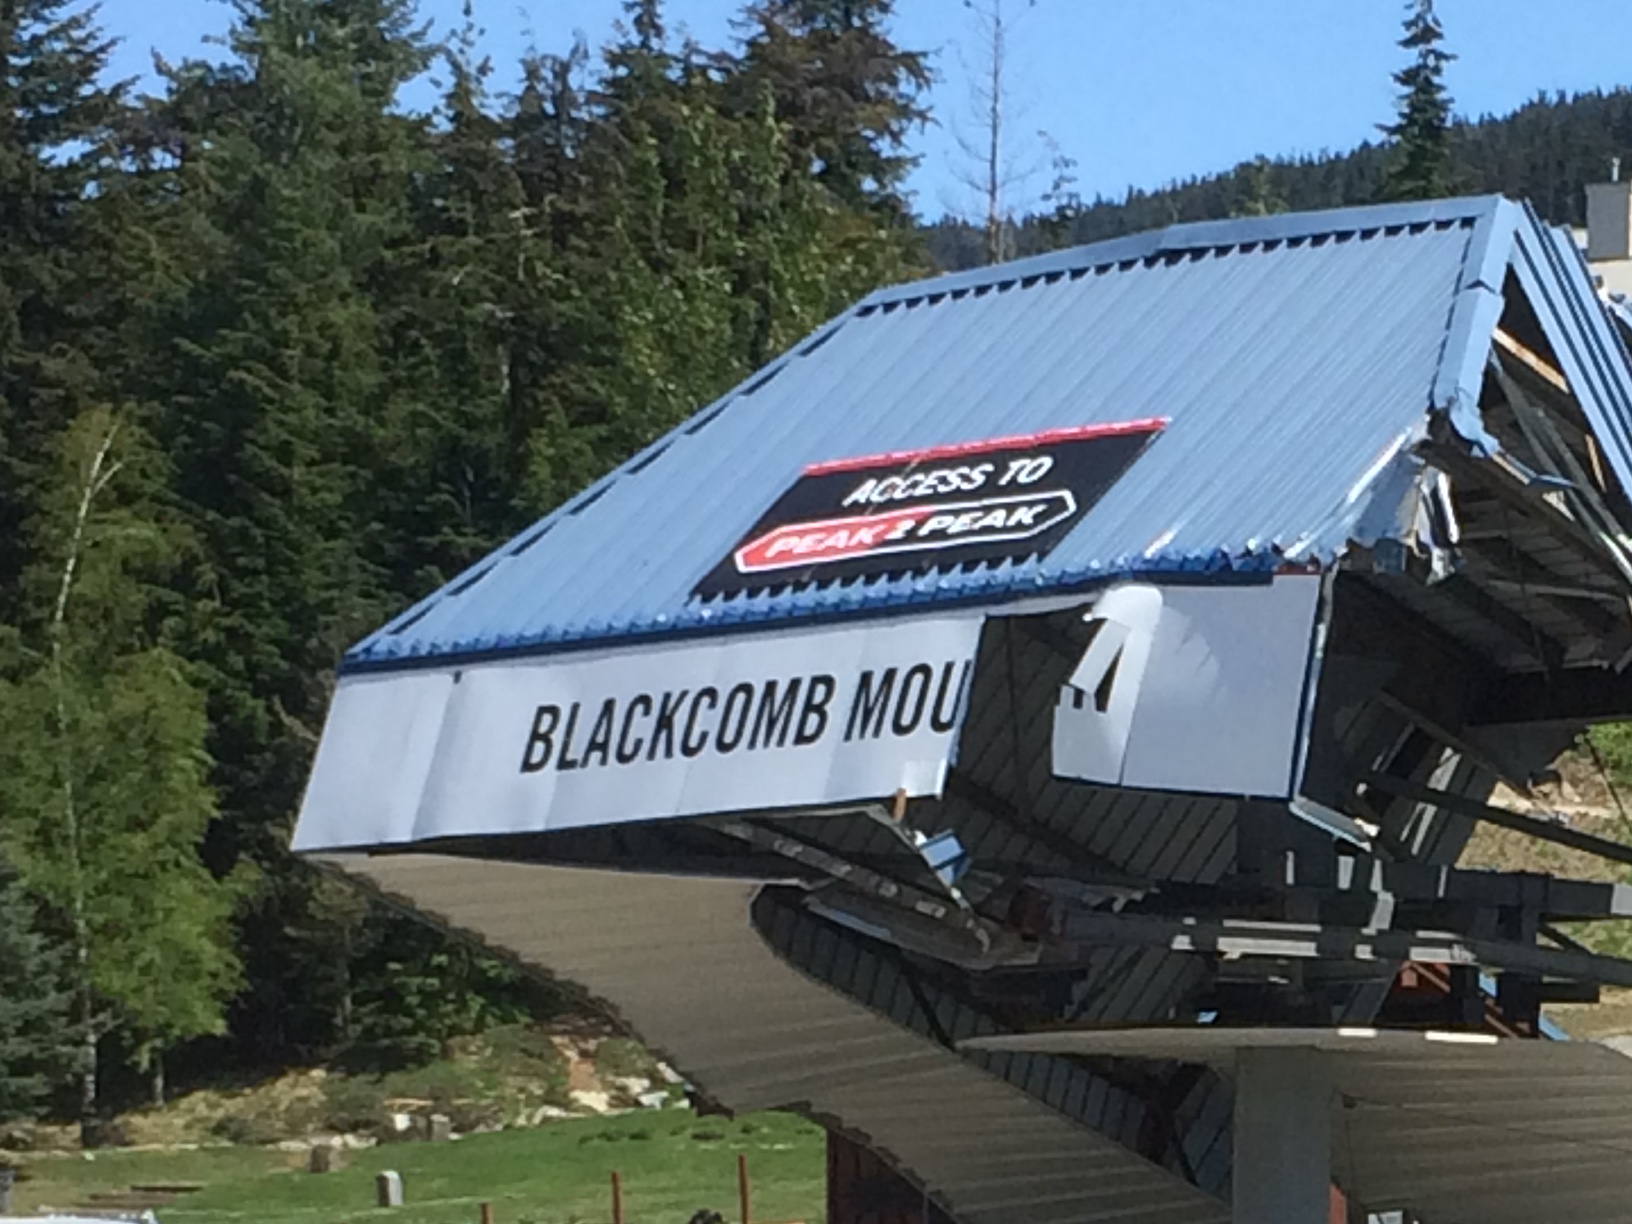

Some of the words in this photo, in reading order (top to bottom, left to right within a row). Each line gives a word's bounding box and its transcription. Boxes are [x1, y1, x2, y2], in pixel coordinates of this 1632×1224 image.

[842, 463, 993, 508] ACCESS
[998, 455, 1054, 488] TO
[764, 522, 888, 558] PEAK
[885, 517, 919, 540] 2
[916, 503, 1047, 537] PEAK
[520, 674, 836, 773] BLACKCOMB
